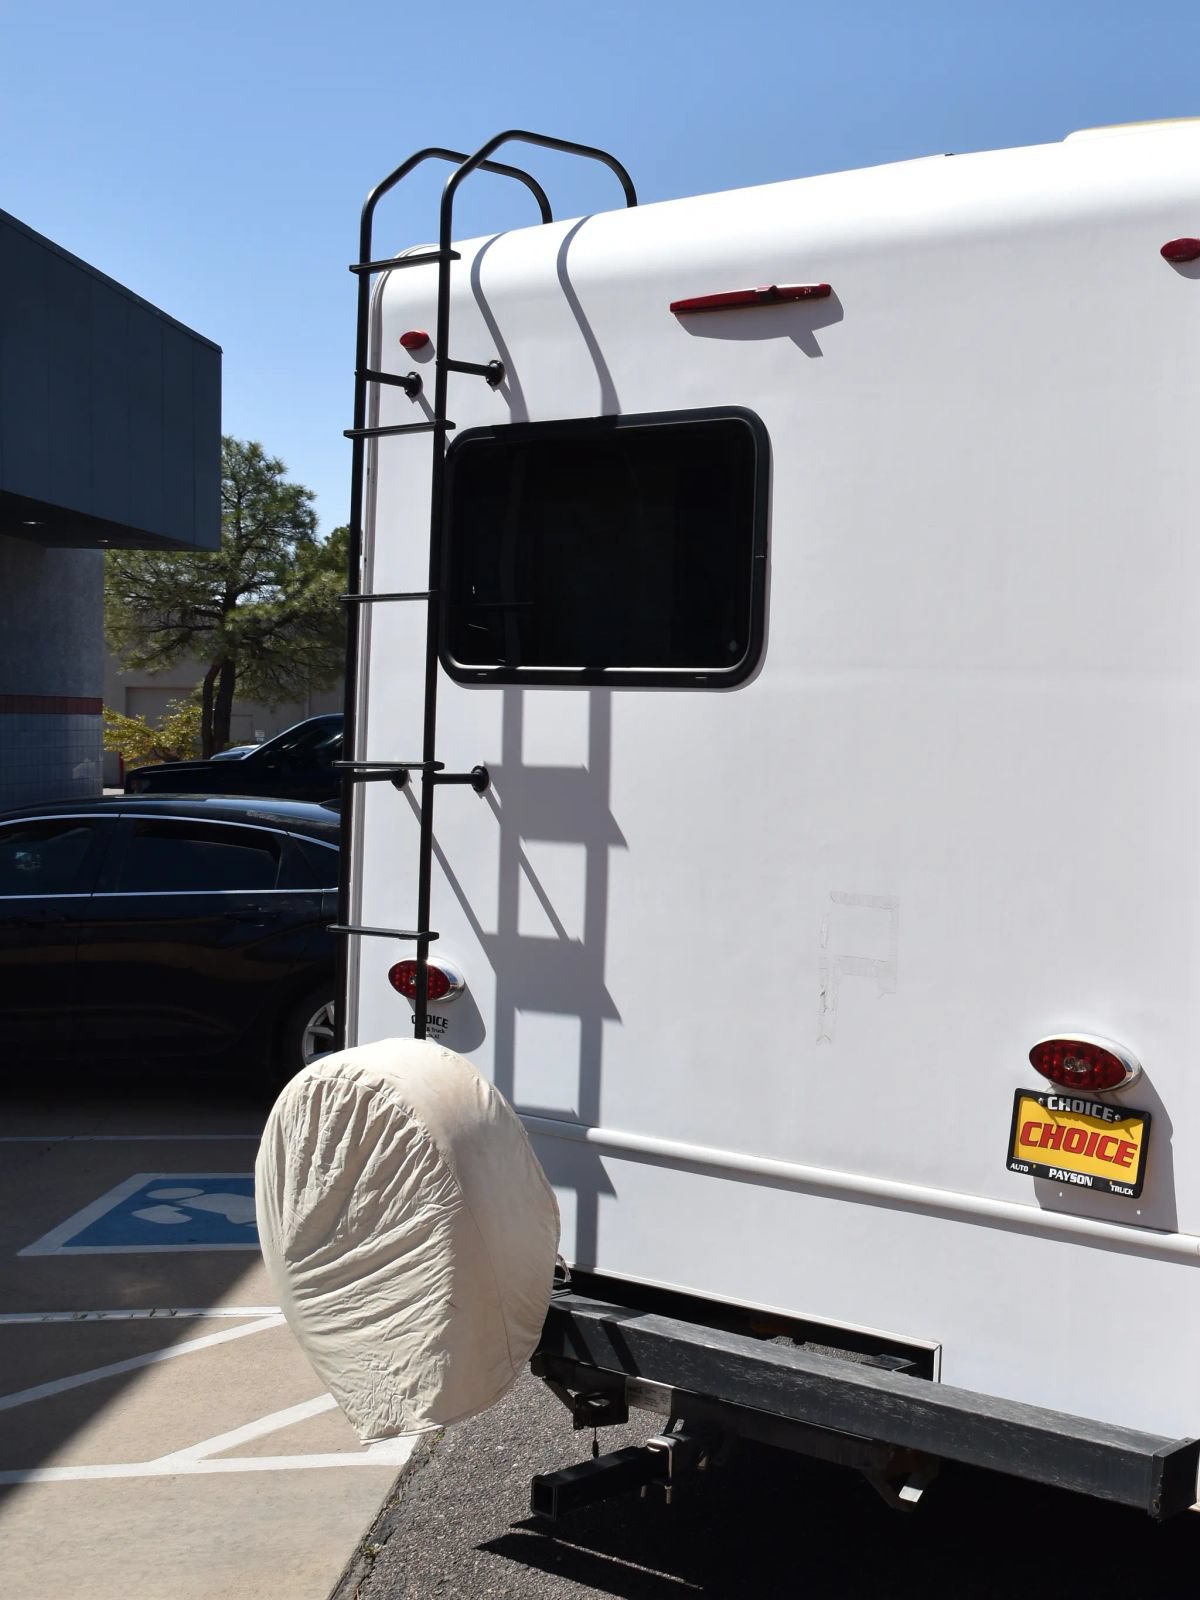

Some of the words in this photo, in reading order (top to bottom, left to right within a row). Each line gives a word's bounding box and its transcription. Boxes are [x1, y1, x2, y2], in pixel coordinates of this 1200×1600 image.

[411, 1014, 448, 1029] COICE
[1047, 1096, 1114, 1122] CHOICE
[1020, 1121, 1138, 1168] CHOICE
[1010, 1162, 1029, 1173] AUTO
[1049, 1168, 1093, 1187] PAYSON
[1110, 1184, 1134, 1196] TRUCK
